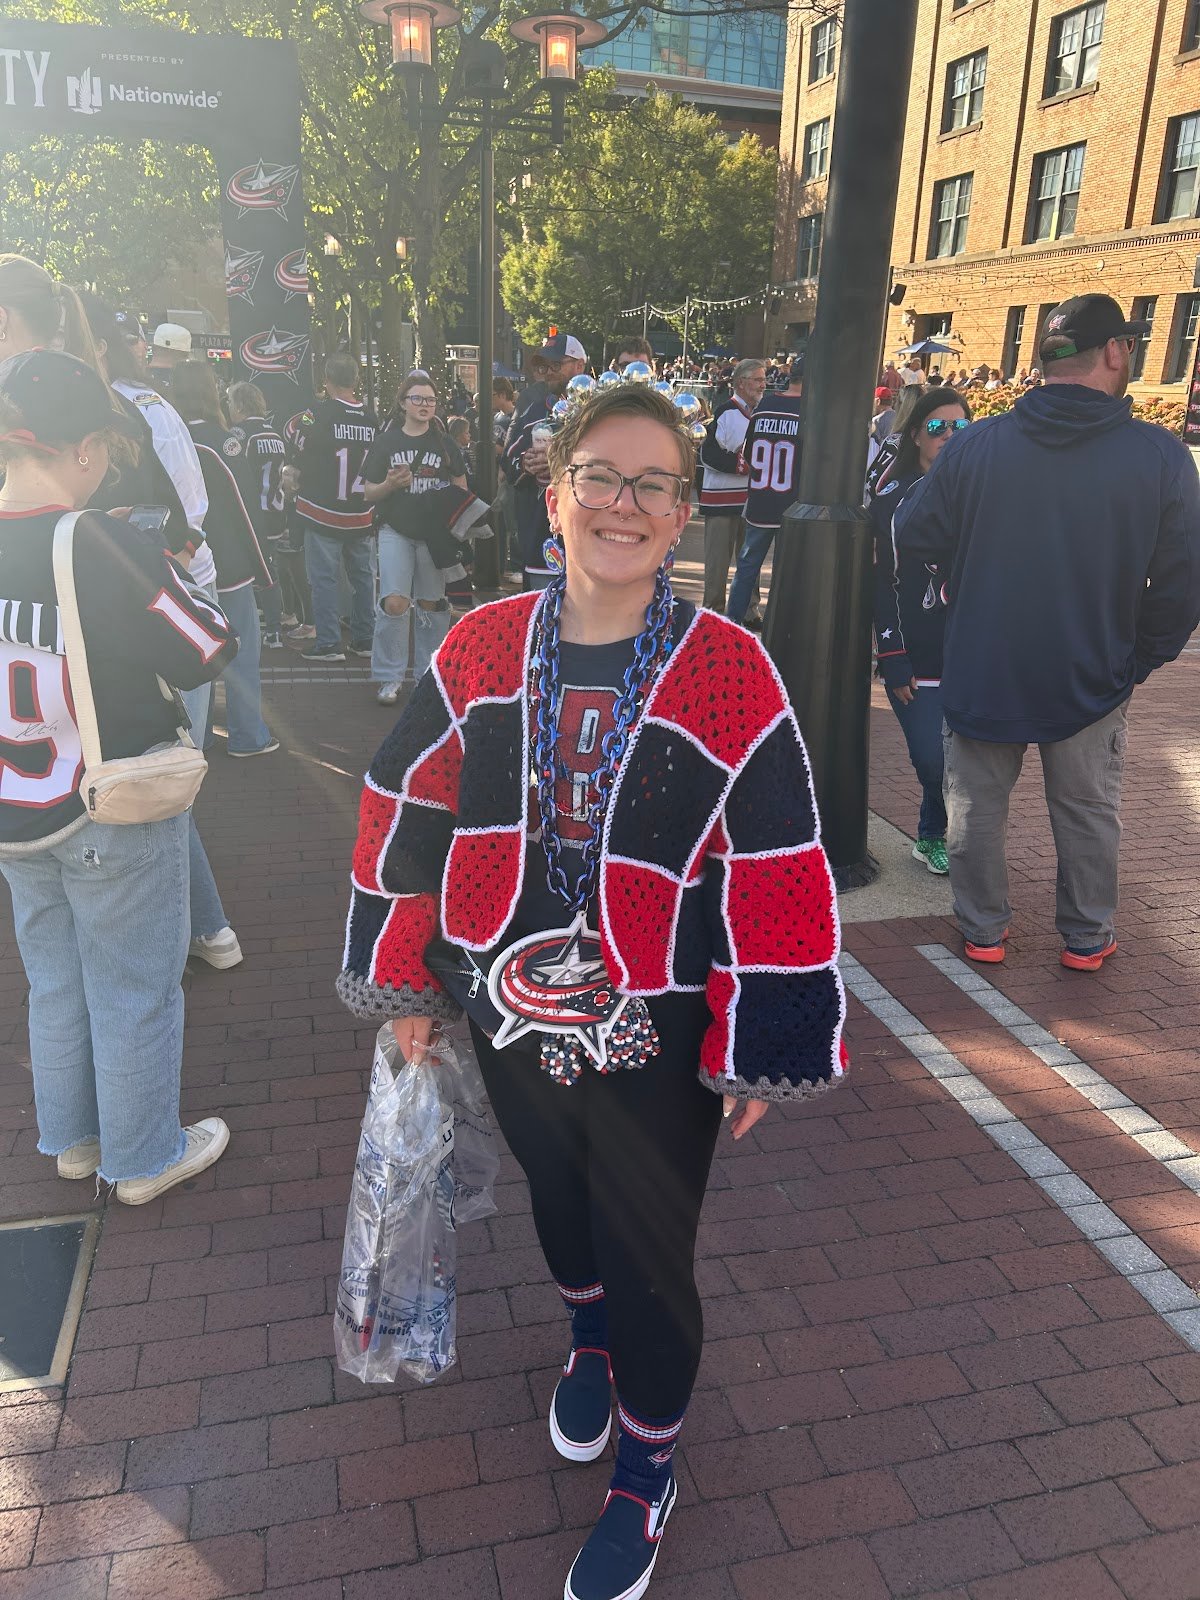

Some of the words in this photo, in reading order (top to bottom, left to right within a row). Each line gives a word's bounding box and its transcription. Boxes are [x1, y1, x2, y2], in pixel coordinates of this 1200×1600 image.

[100, 53, 166, 64] PRESENTED
[171, 56, 185, 65] BY
[0, 48, 51, 107] TY
[109, 84, 219, 109] Nationwide
[200, 336, 221, 347] PLAZA
[333, 423, 376, 442] WHITNEY
[750, 438, 796, 491] 90
[877, 449, 893, 466] 17
